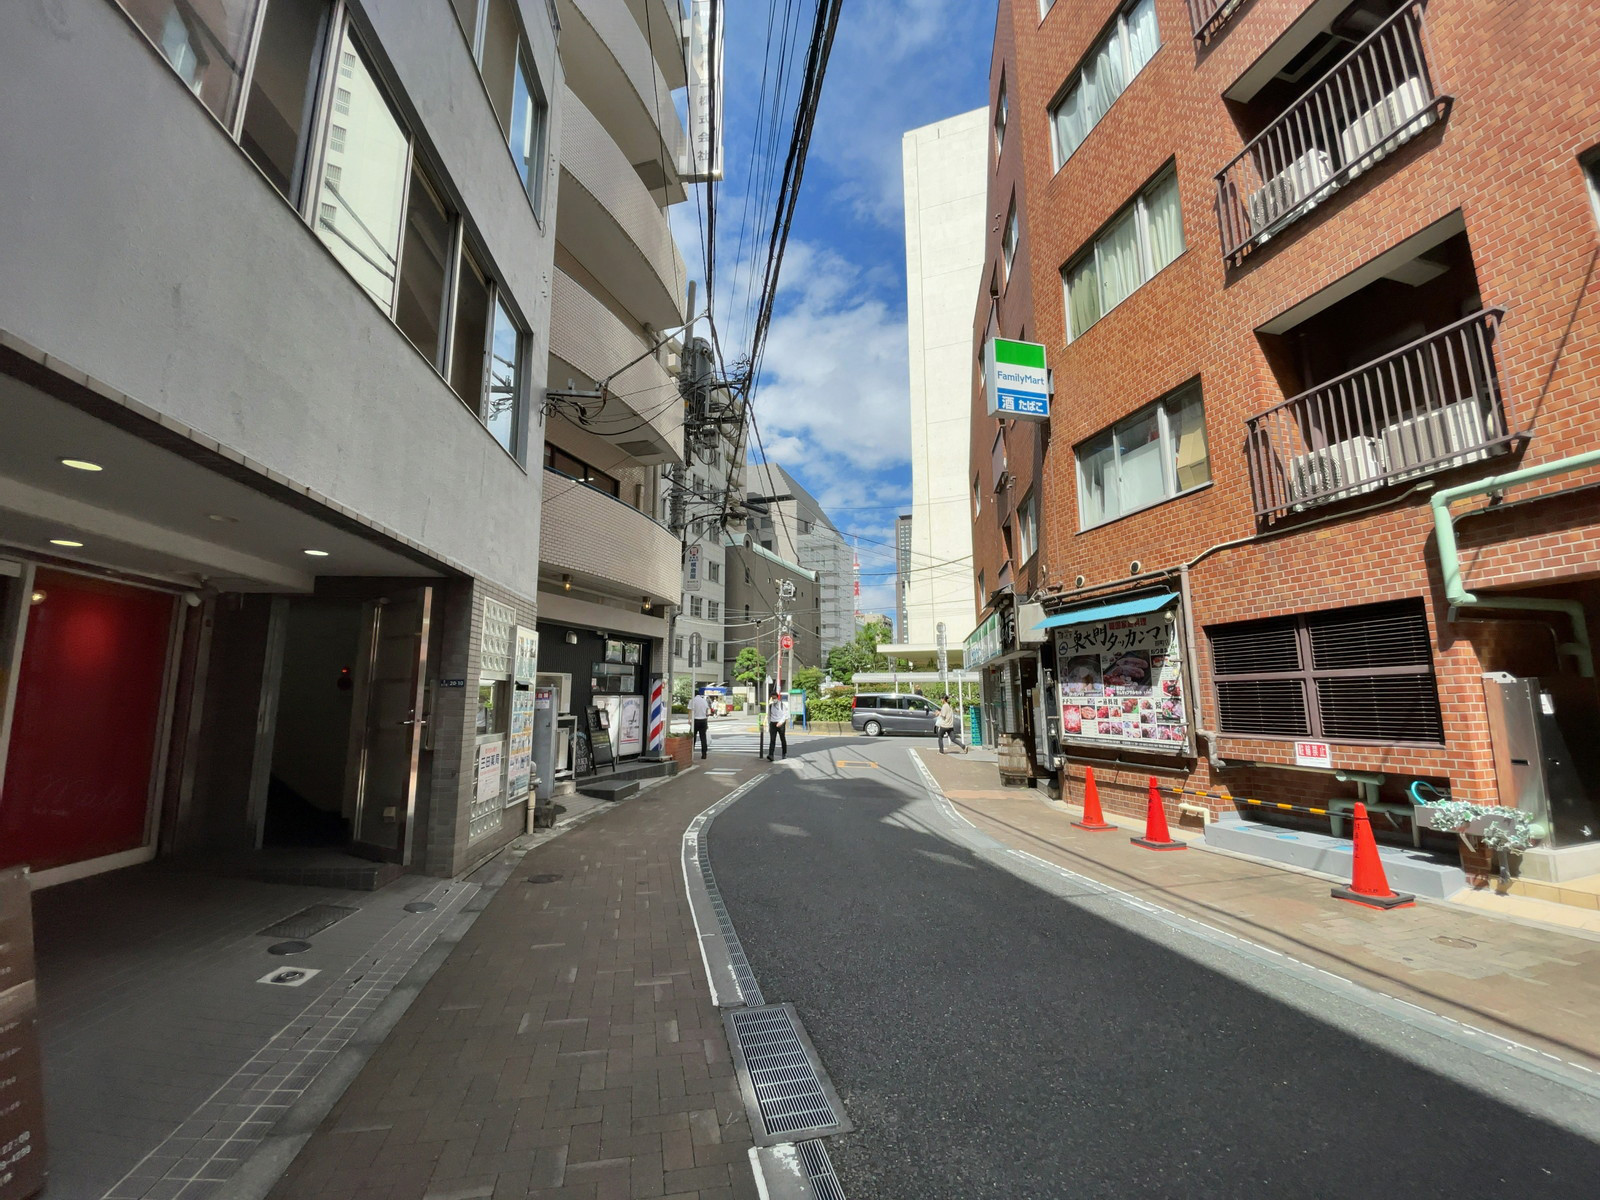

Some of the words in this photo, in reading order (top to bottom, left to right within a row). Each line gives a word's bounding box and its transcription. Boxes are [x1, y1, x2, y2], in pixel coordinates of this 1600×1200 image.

[997, 370, 1044, 385] FamilyMart
[1001, 396, 1014, 410] 酒
[1018, 399, 1043, 412] たばこ
